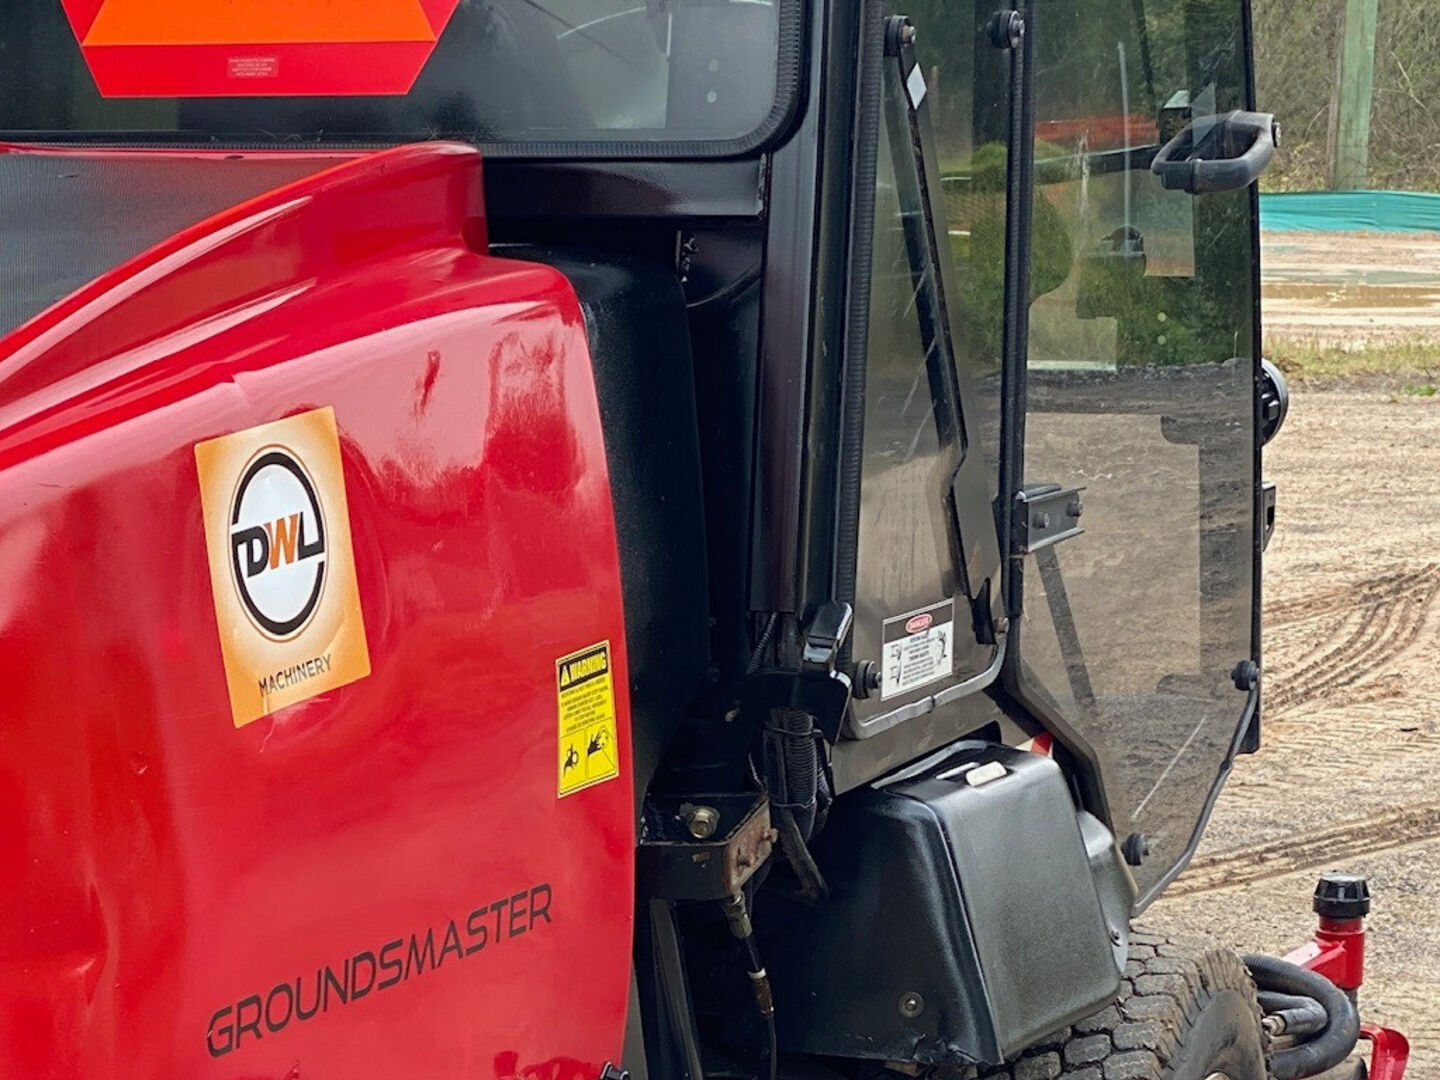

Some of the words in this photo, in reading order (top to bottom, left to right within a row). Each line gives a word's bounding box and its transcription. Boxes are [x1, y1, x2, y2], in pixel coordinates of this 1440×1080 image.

[233, 511, 325, 578] DWL
[258, 653, 333, 698] MACHINERY
[206, 882, 553, 1058] GROUNDSMASTER
